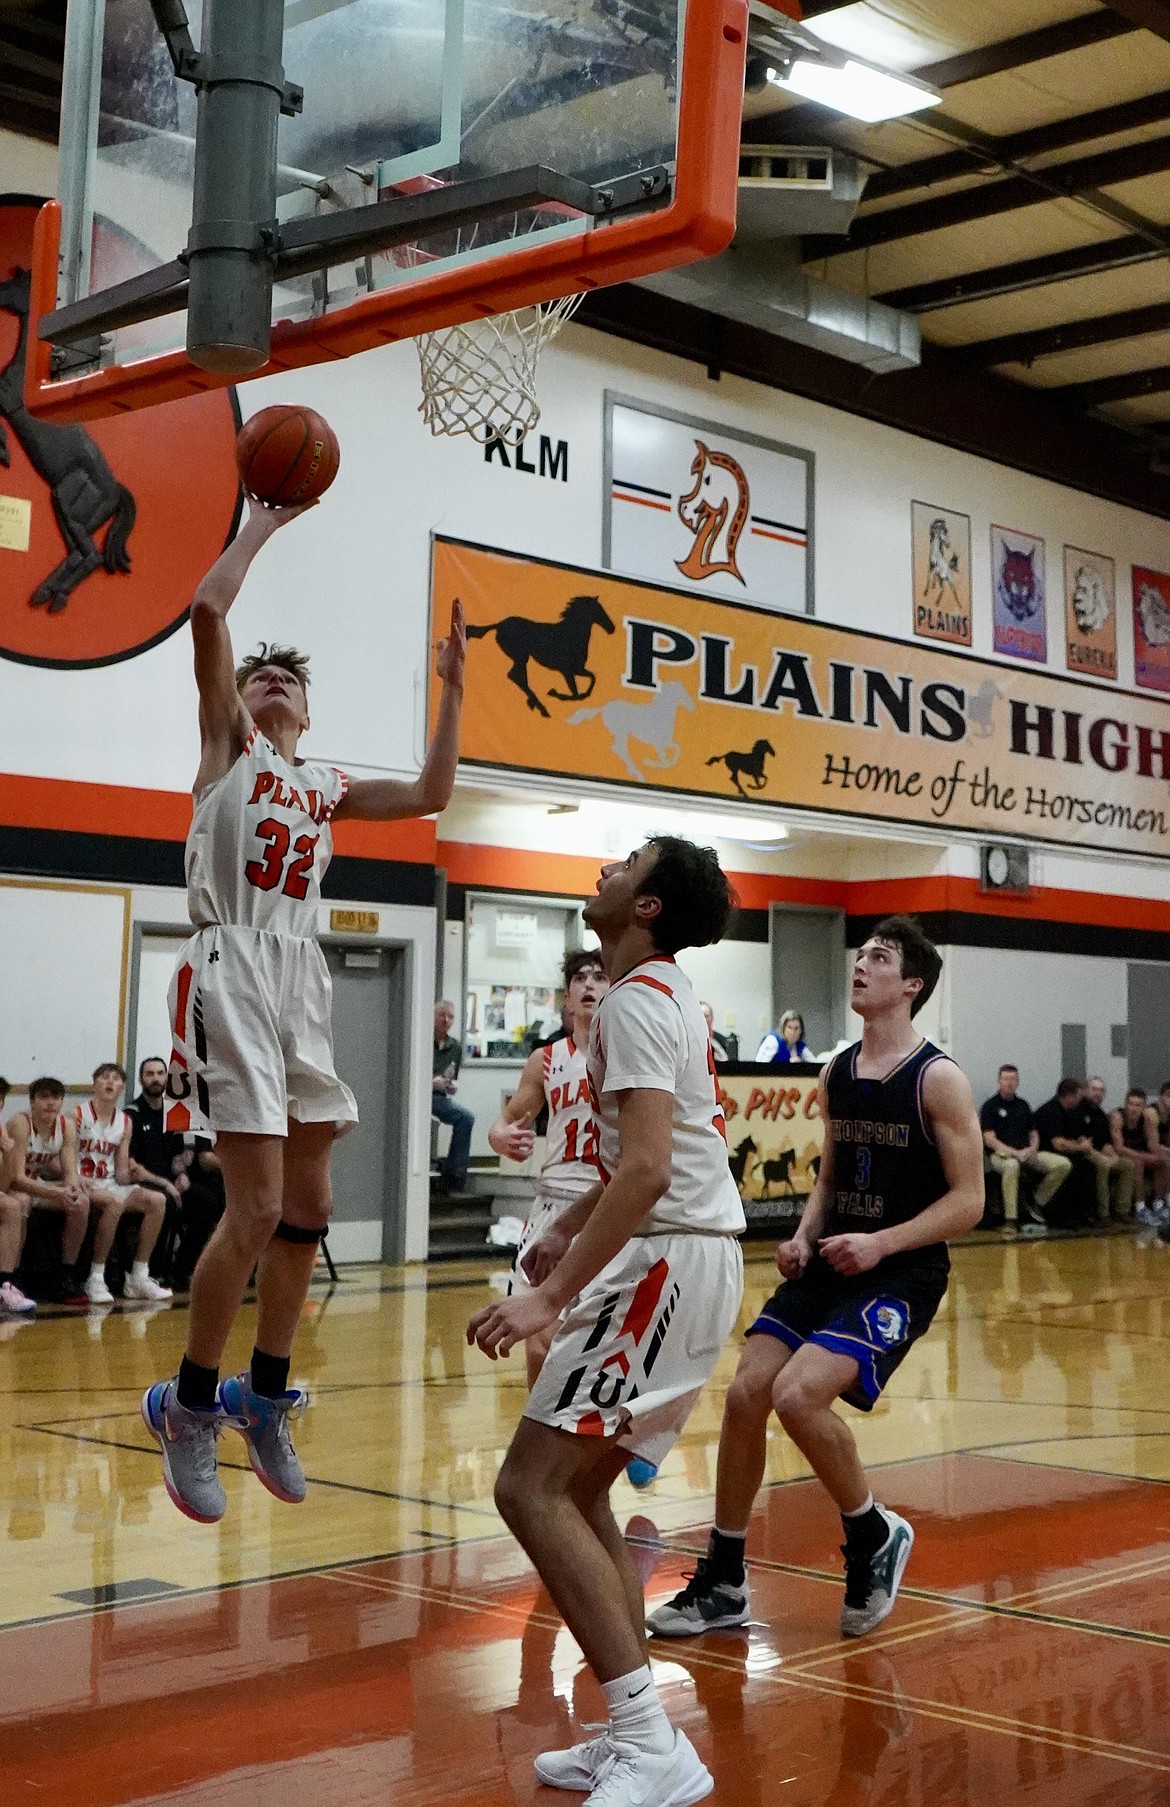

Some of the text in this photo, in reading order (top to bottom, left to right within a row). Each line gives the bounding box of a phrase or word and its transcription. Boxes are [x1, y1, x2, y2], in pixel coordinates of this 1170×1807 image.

[484, 424, 568, 482] KLM
[917, 605, 969, 637] PLAINS
[626, 620, 1170, 781] PLAINS HIGH
[822, 753, 1169, 835] Home of the Horsemen
[245, 817, 320, 901] 32
[744, 1086, 801, 1122] PHS
[855, 1146, 872, 1191] 3
[836, 1191, 884, 1218] FALLS
